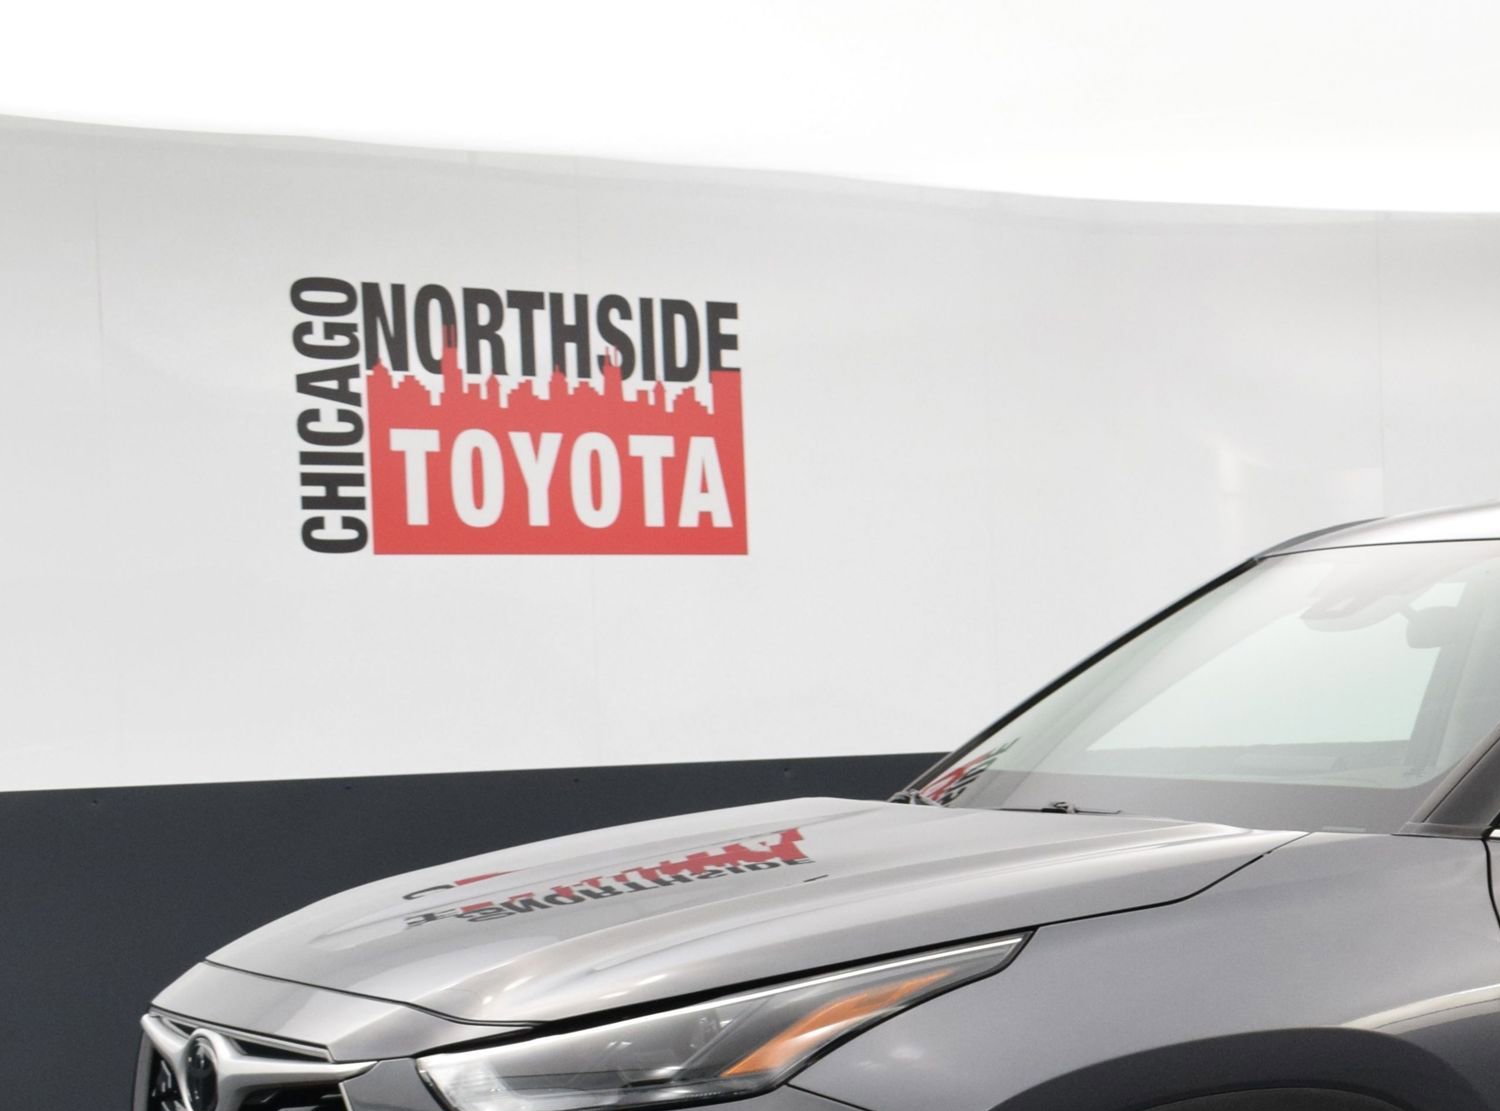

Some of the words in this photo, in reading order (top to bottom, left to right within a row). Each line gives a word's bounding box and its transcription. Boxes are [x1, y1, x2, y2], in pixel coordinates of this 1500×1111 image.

[361, 281, 741, 384] NORTHSIDE
[290, 276, 368, 554] CHICAGO
[389, 428, 733, 528] TOYOTA
